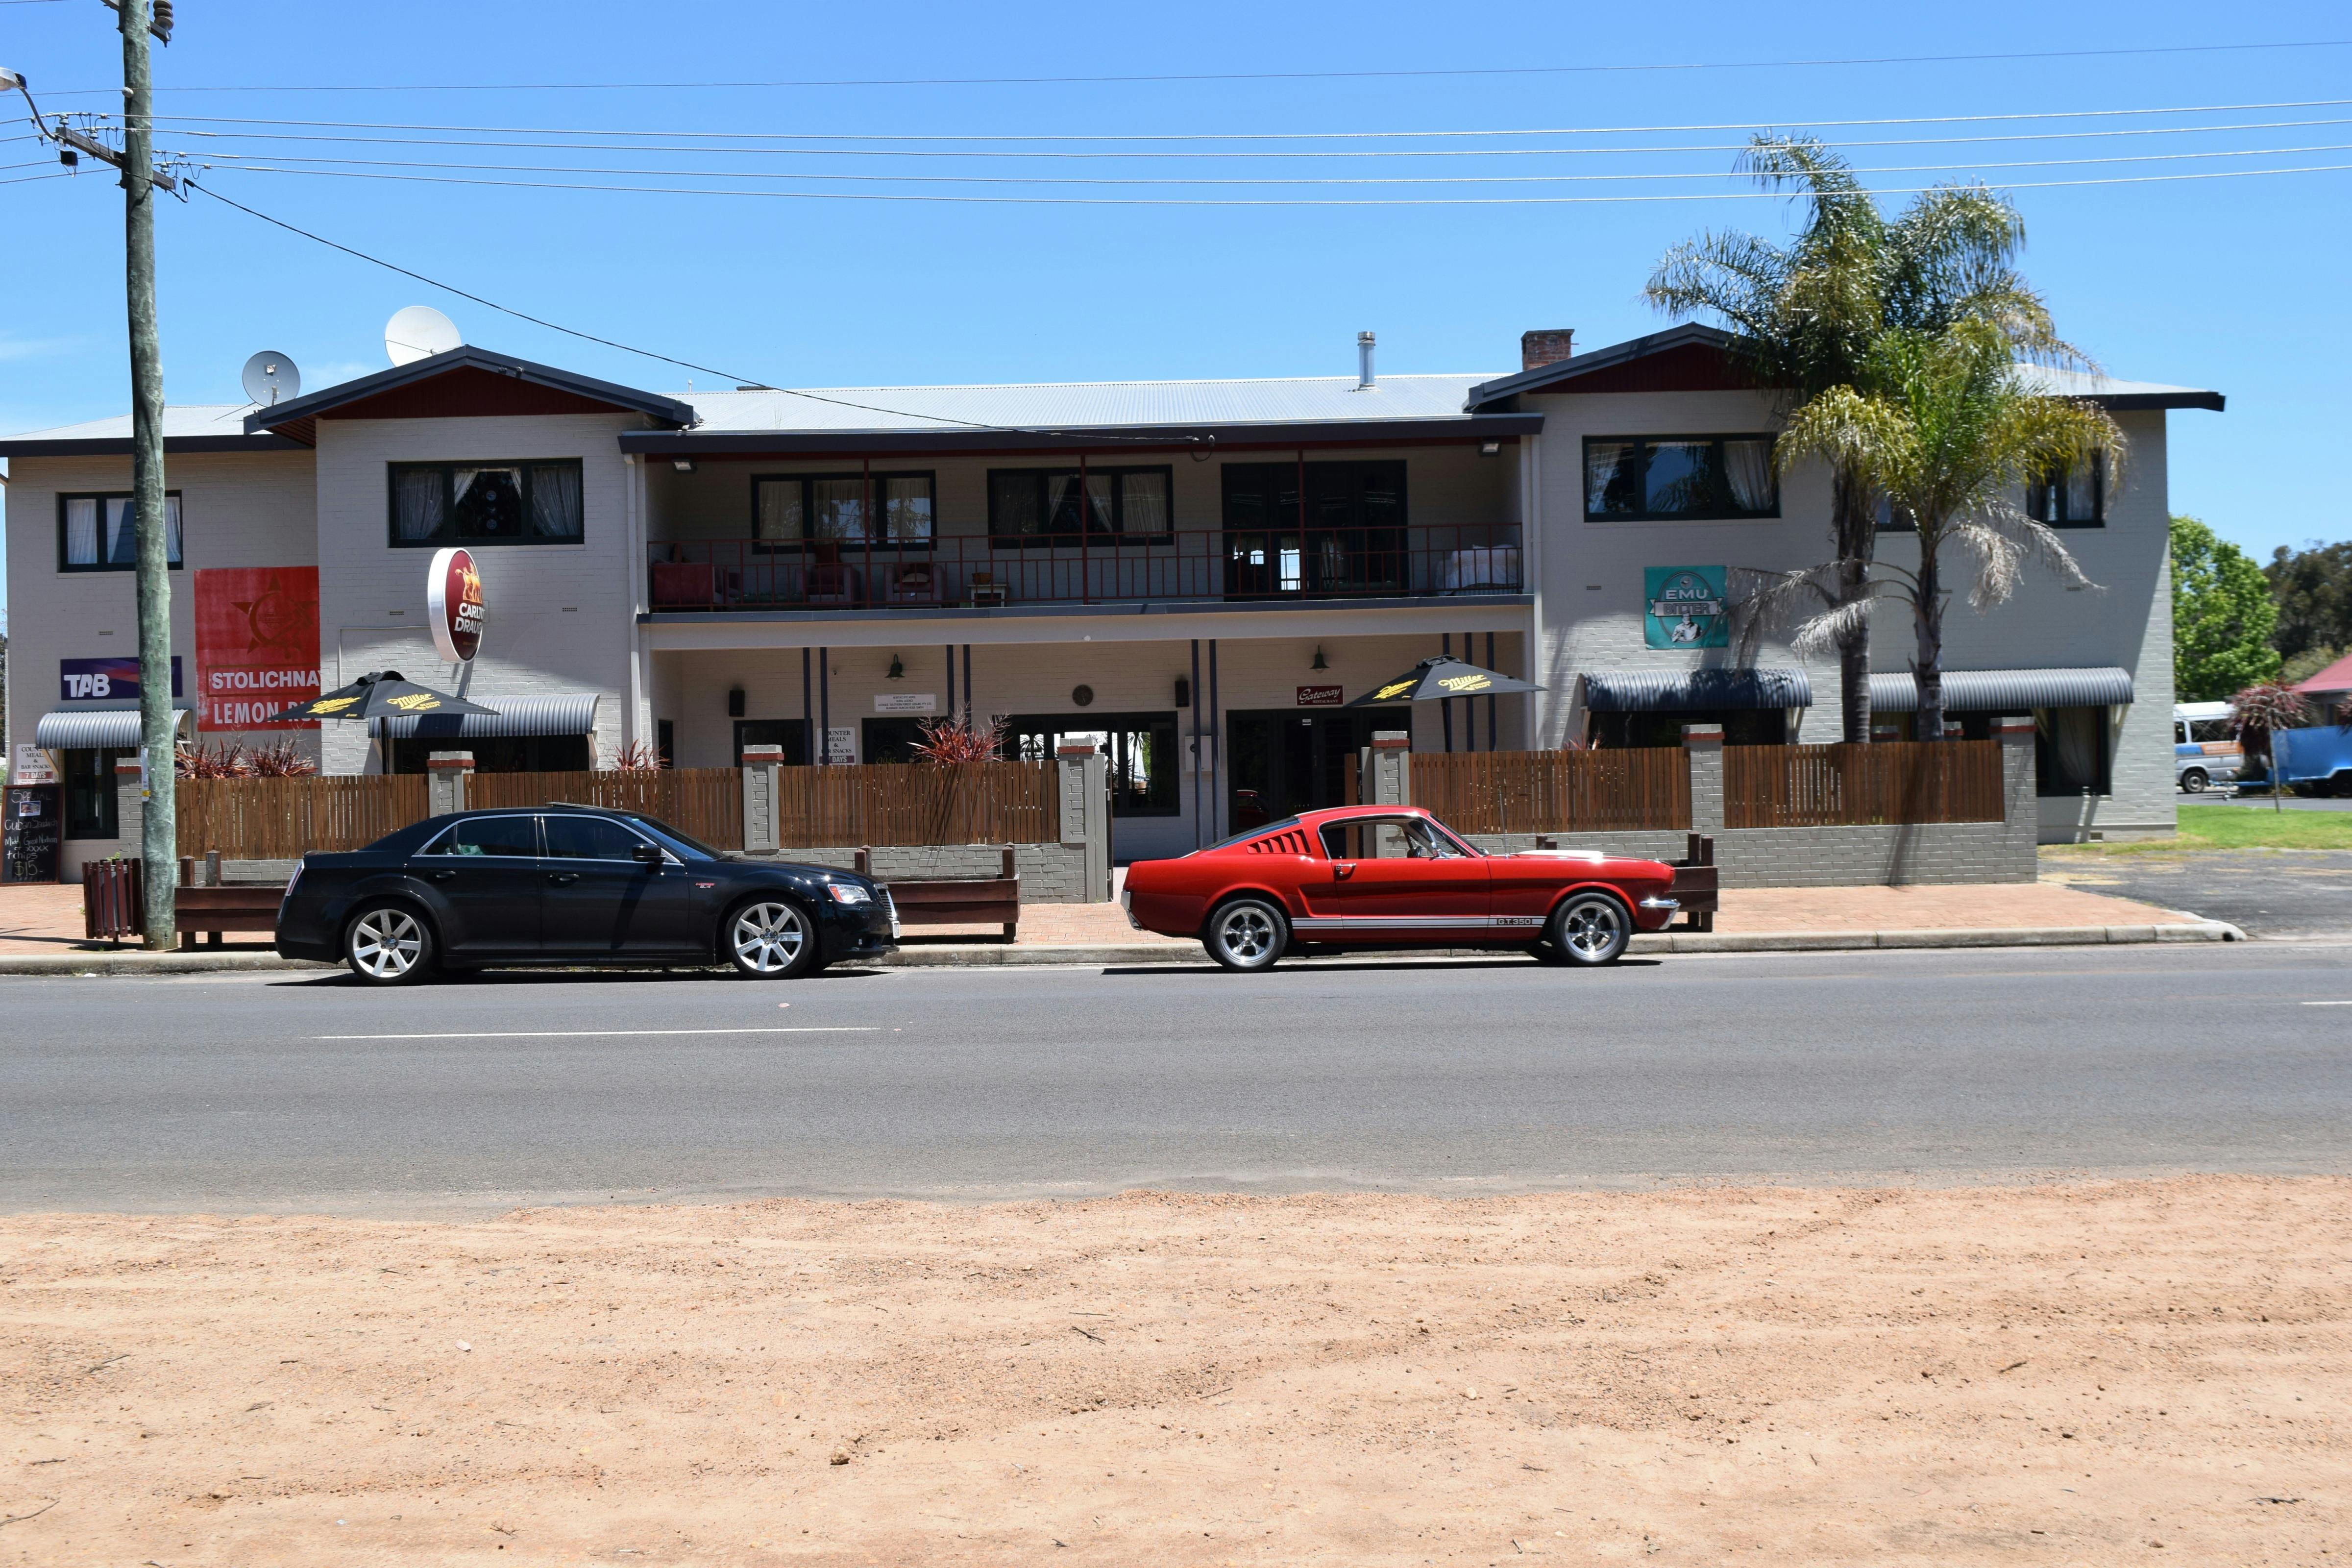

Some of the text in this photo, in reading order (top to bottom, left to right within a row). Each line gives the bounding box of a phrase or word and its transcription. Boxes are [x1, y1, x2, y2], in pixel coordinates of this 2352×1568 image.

[1666, 589, 1707, 599] EMU
[459, 602, 484, 620] CARLTO
[1663, 603, 1710, 614] BITTER
[454, 616, 482, 634] DRAUG
[64, 674, 110, 697] TAB
[212, 670, 320, 688] STOLICHNA
[1438, 675, 1484, 688] Miller
[387, 693, 431, 707] Miller
[1299, 688, 1341, 703] Gateway
[214, 702, 279, 724] LEMON
[11, 789, 51, 803] SPECIAL
[4, 819, 31, 831] Cuban
